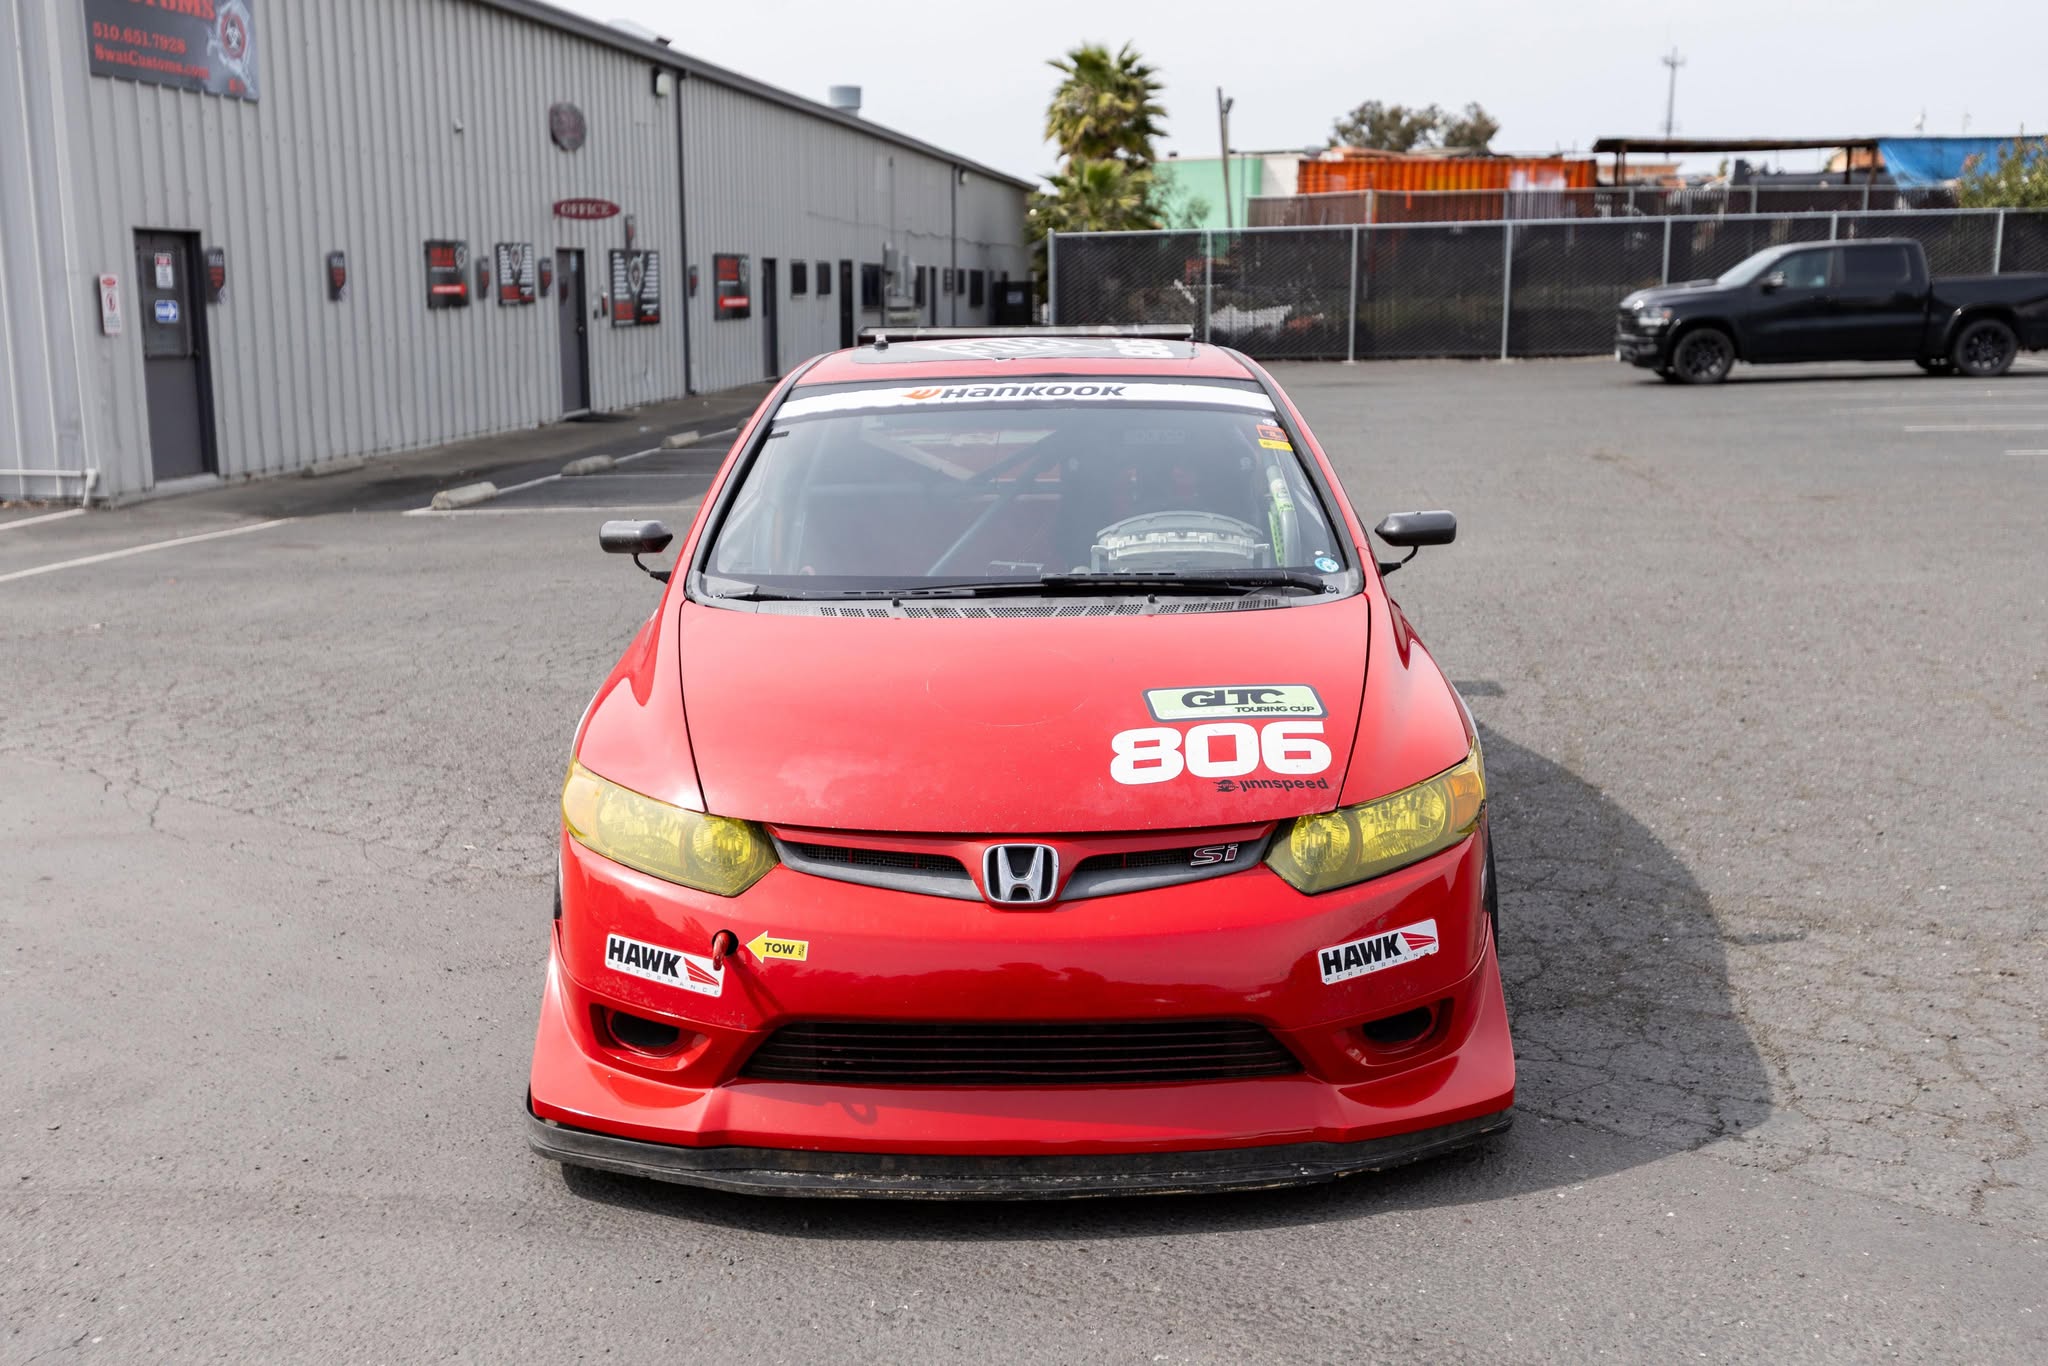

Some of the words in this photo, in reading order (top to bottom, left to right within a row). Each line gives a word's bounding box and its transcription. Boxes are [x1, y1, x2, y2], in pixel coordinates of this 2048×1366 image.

[1181, 688, 1286, 709] GLTC
[1234, 705, 1288, 713] TOURING
[1110, 721, 1332, 785] 806
[1190, 843, 1239, 866] Si
[608, 937, 682, 978] HAWK
[764, 942, 795, 955] TOW
[1321, 932, 1403, 976] HAWK
[607, 961, 719, 996] PERFORMANCE
